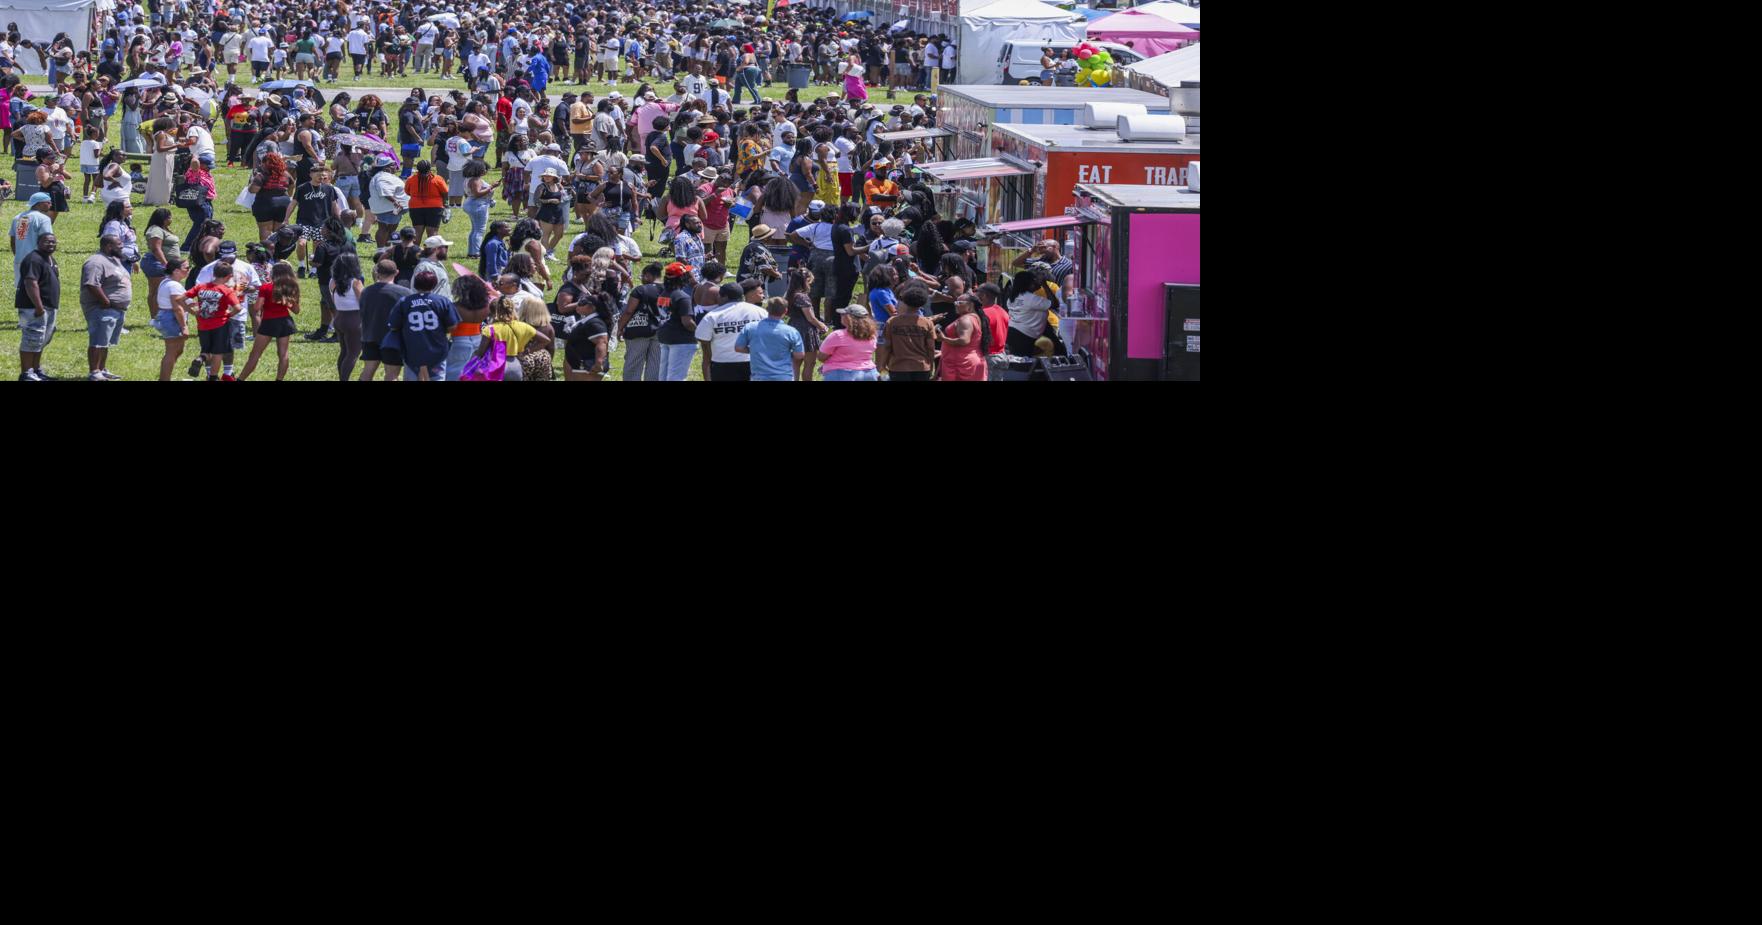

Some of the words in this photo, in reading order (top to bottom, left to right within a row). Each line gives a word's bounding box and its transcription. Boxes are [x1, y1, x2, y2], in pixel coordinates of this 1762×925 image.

[1079, 164, 1112, 184] EAT
[408, 310, 439, 332] 99
[717, 319, 759, 328] FEDER
